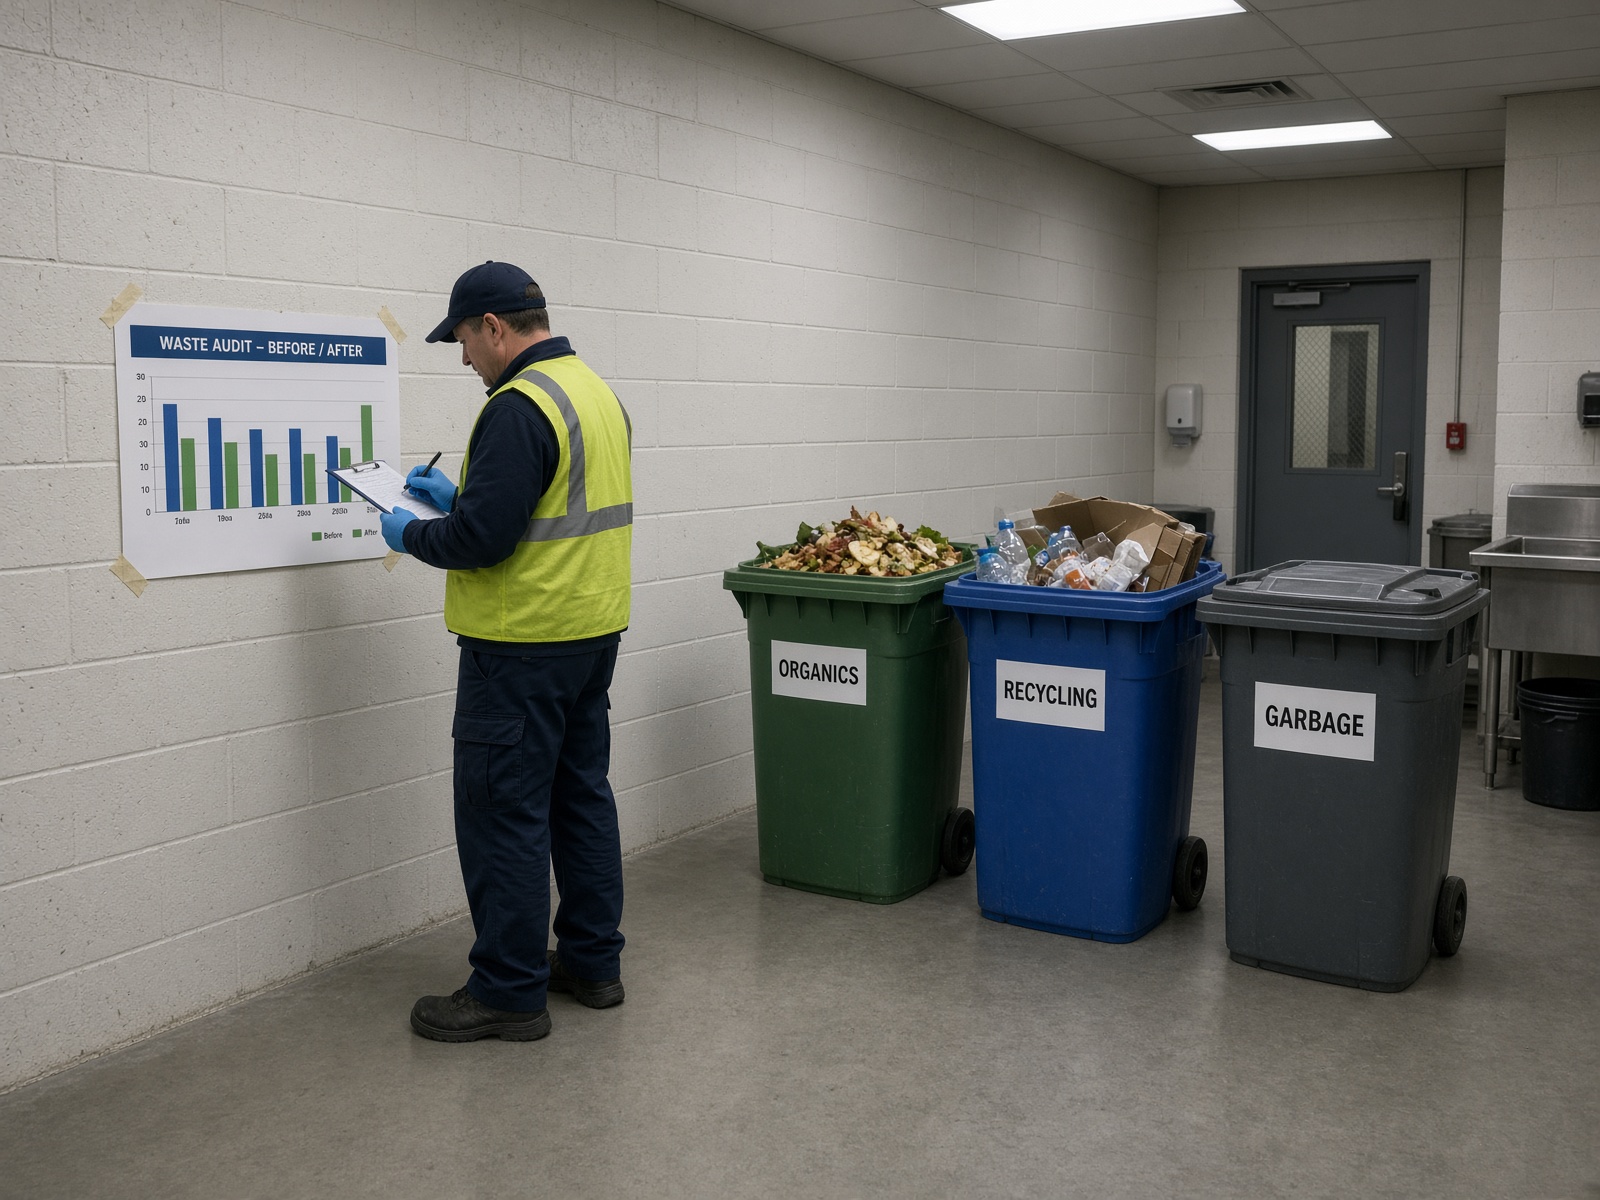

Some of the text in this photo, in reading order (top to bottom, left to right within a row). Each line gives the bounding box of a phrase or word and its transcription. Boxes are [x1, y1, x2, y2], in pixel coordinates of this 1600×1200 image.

[159, 335, 208, 352] WASTE
[212, 338, 252, 353] AUDIT
[268, 340, 316, 356] BEFORE
[318, 342, 325, 357] /
[327, 343, 363, 358] AFTER
[138, 418, 148, 426] 20
[139, 440, 149, 448] 30
[140, 463, 149, 471] 10
[141, 485, 150, 494] 10
[146, 508, 151, 516] 0
[323, 529, 378, 540] Before After
[778, 658, 859, 686] ORGANICS
[1003, 678, 1098, 709] RECYCLING
[1264, 703, 1365, 737] GARBAGE
